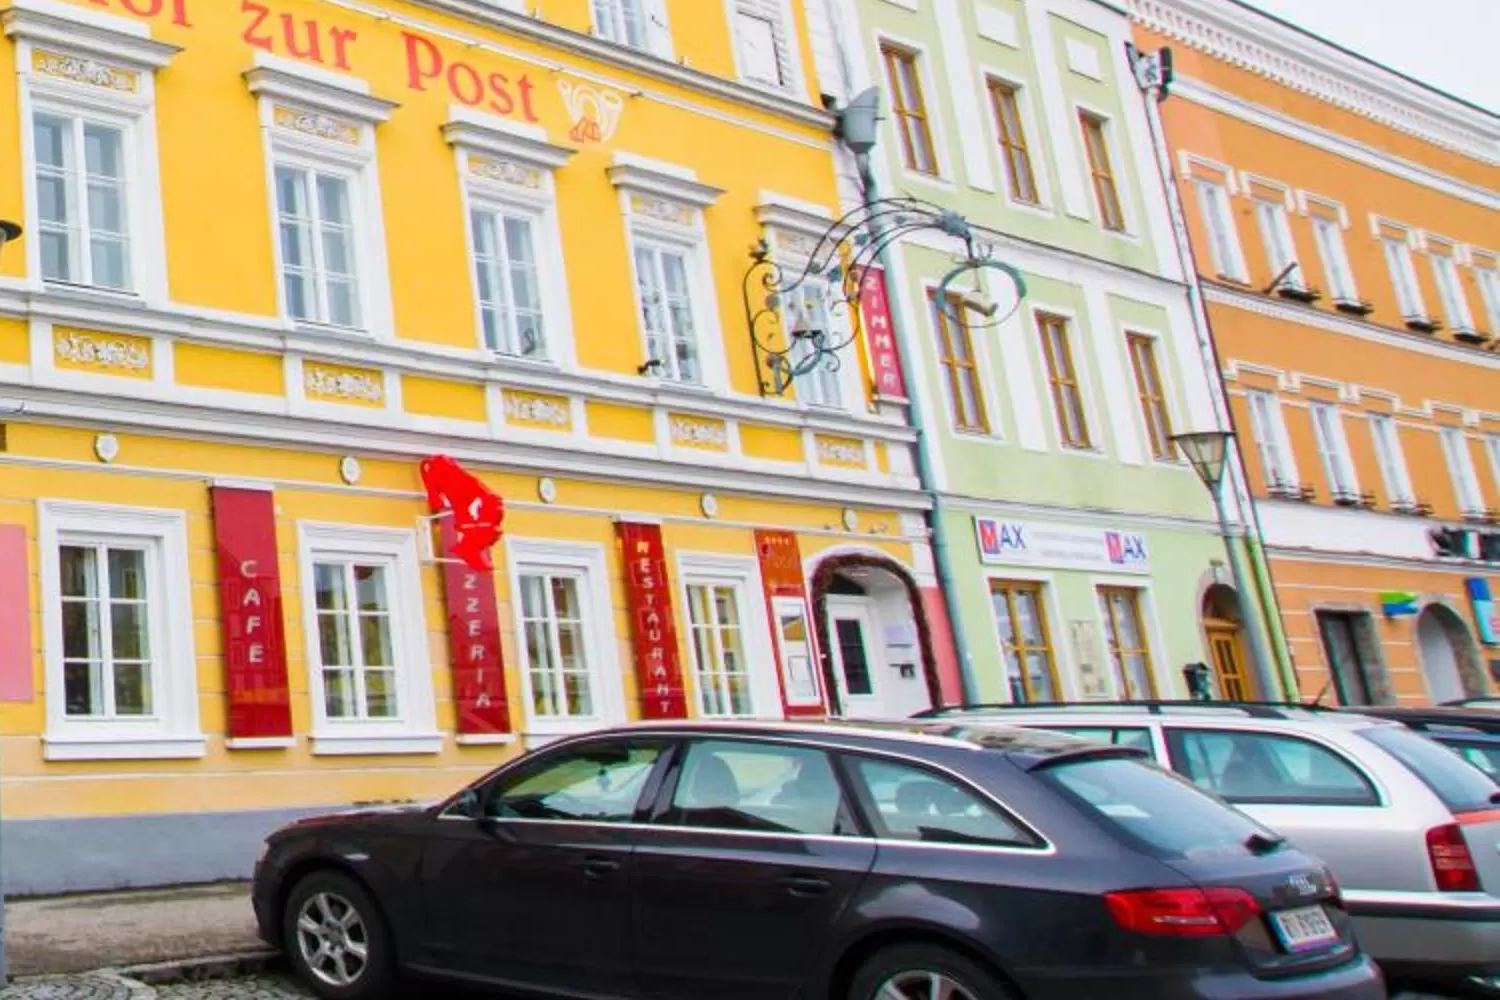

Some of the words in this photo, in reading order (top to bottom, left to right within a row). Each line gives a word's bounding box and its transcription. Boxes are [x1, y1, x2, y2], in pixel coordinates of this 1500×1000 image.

[399, 29, 539, 123] Post
[864, 275, 896, 386] ZIMMER
[978, 519, 1026, 555] MAX
[1105, 531, 1147, 565] MAX
[463, 573, 492, 709] ZZERIA
[636, 541, 671, 713] RESTAURANT
